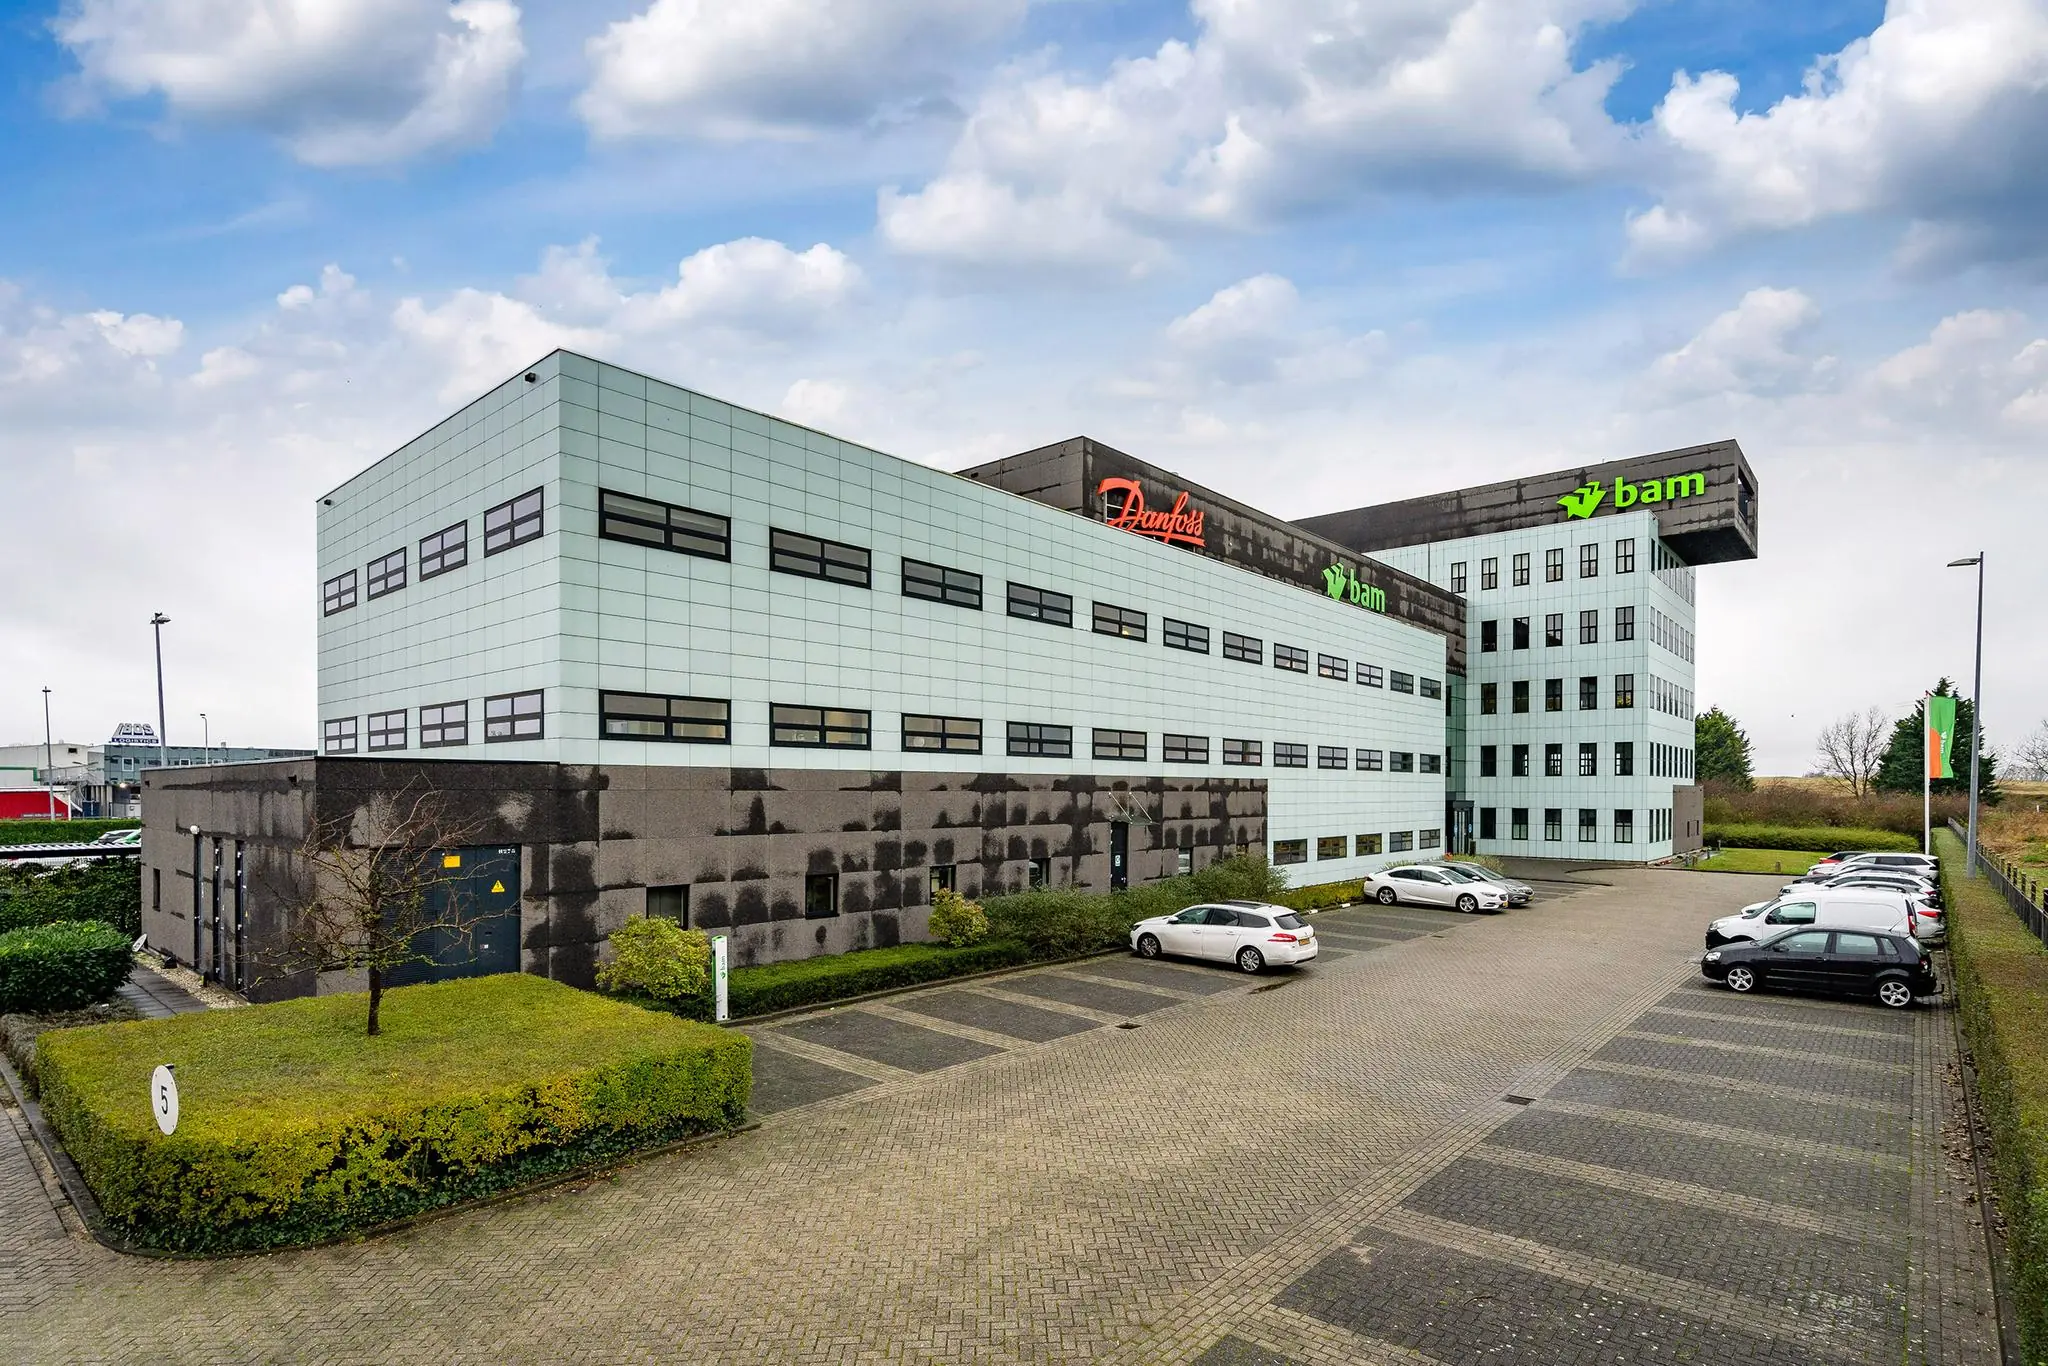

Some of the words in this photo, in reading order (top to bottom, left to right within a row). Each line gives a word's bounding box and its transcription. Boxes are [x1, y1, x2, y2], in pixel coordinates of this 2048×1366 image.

[1615, 472, 1705, 508] bam
[1096, 477, 1206, 546] Danfoss
[1350, 568, 1385, 613] bam
[160, 1085, 169, 1115] 5
